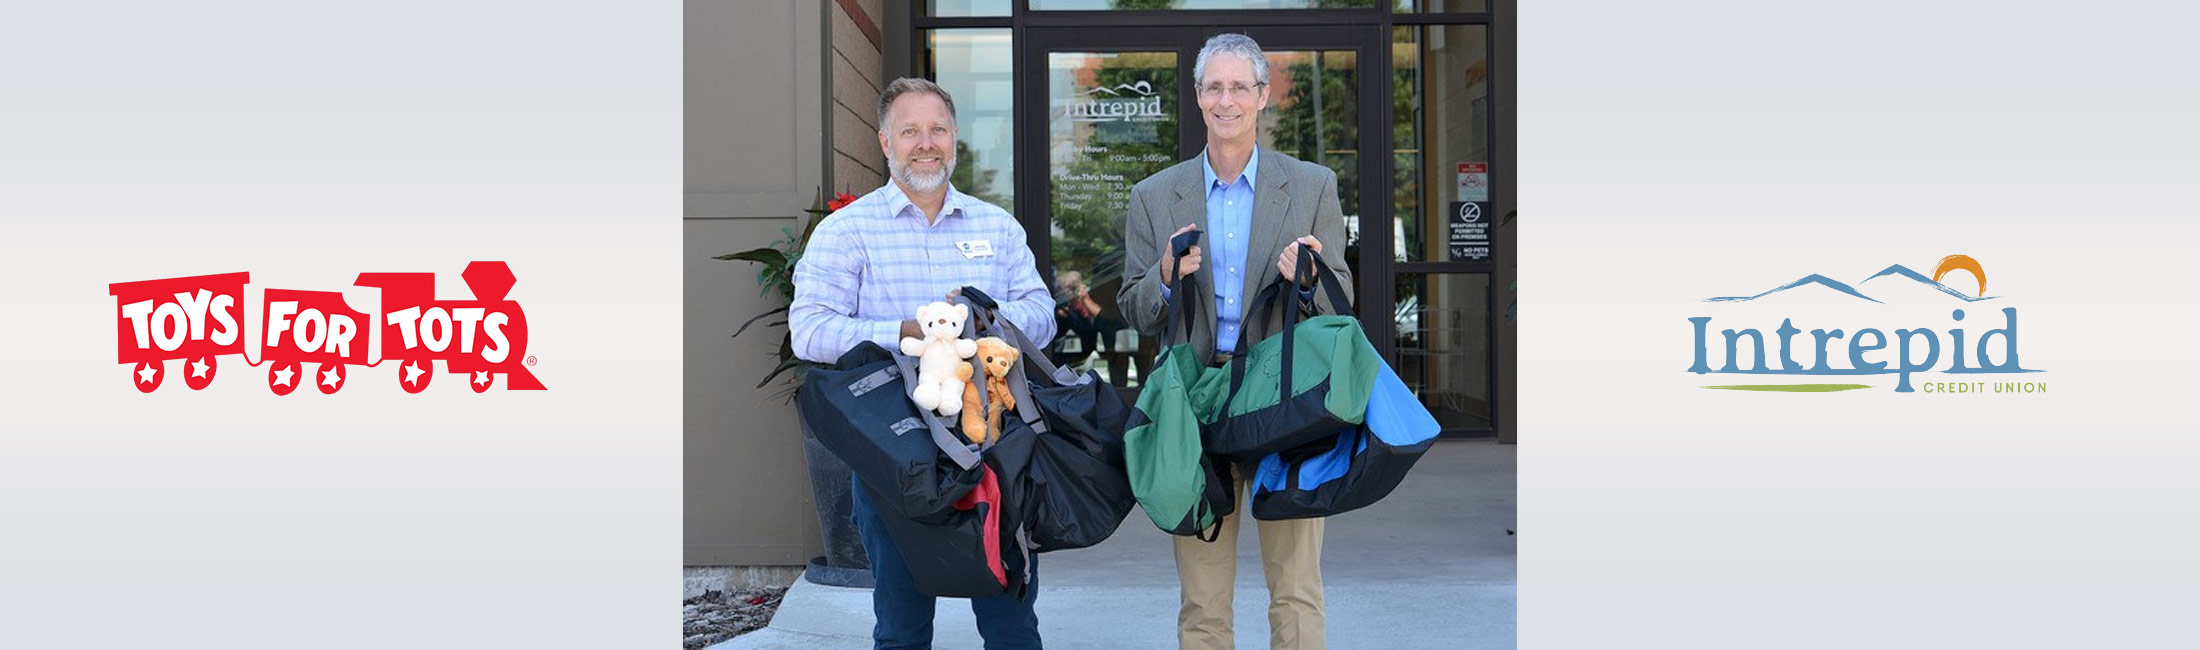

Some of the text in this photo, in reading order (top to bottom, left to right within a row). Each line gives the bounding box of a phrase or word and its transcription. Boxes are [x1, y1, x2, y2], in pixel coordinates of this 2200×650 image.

[1064, 96, 1161, 121] Intrepid
[1060, 173, 1124, 181] Drive-Thru Hours
[1060, 193, 1093, 201] Thursday
[1060, 202, 1082, 210] Friday
